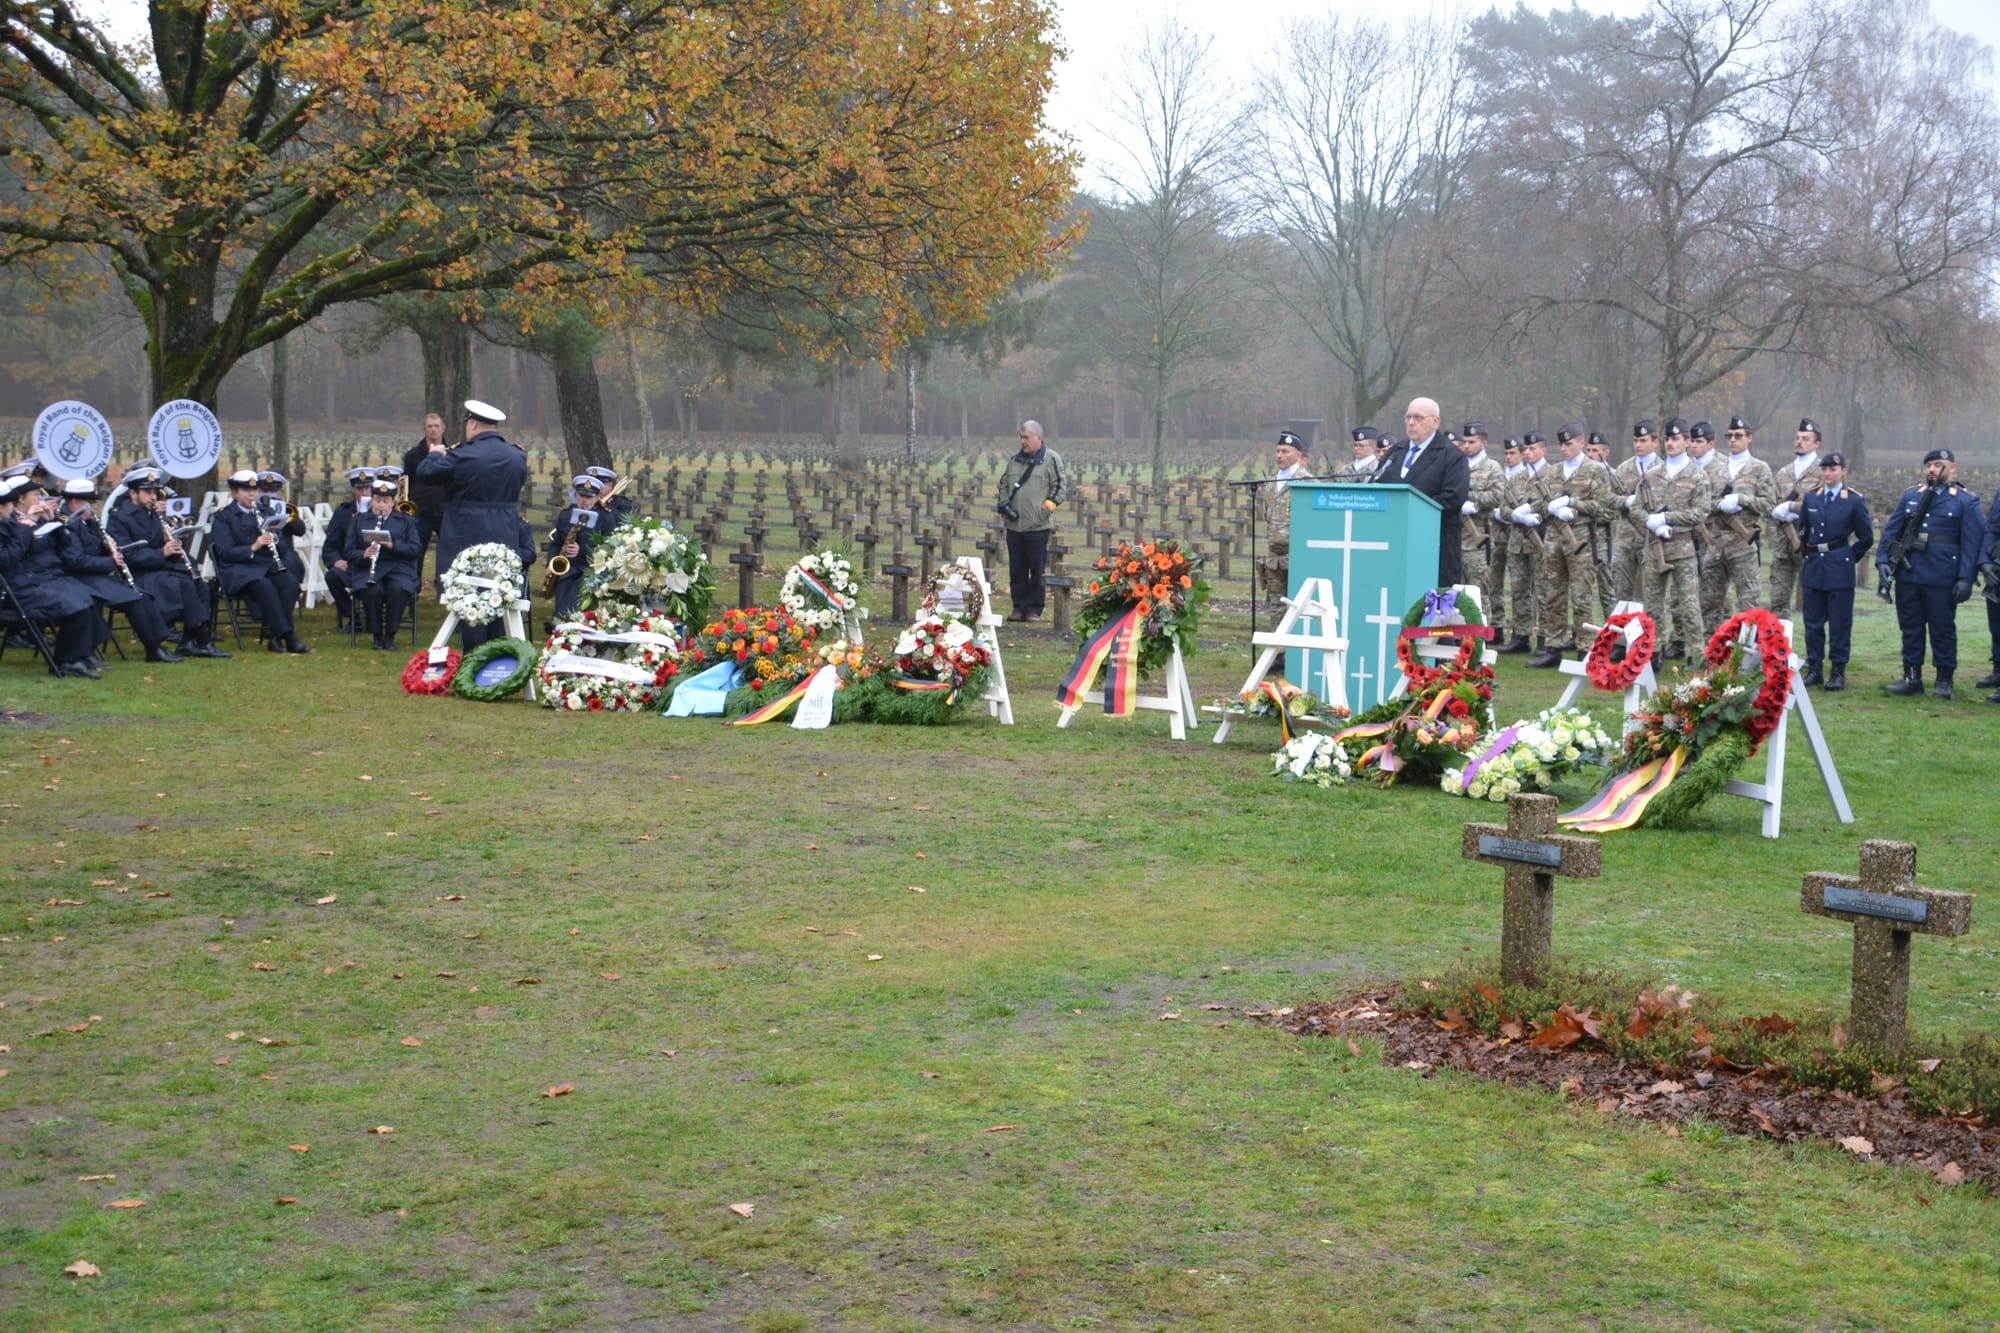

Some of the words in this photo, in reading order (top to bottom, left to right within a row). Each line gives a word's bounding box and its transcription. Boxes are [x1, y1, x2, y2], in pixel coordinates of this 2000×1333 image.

[46, 406, 69, 422] Band
[71, 406, 82, 414] of
[83, 410, 98, 423] the
[165, 405, 174, 415] of
[175, 402, 190, 410] the
[152, 413, 166, 437] Band
[193, 404, 218, 432] Belgian
[38, 421, 49, 449] Royal
[98, 423, 112, 459] Belgian
[152, 440, 169, 466] Royal
[209, 434, 221, 458] Navy
[85, 460, 106, 478] Navy
